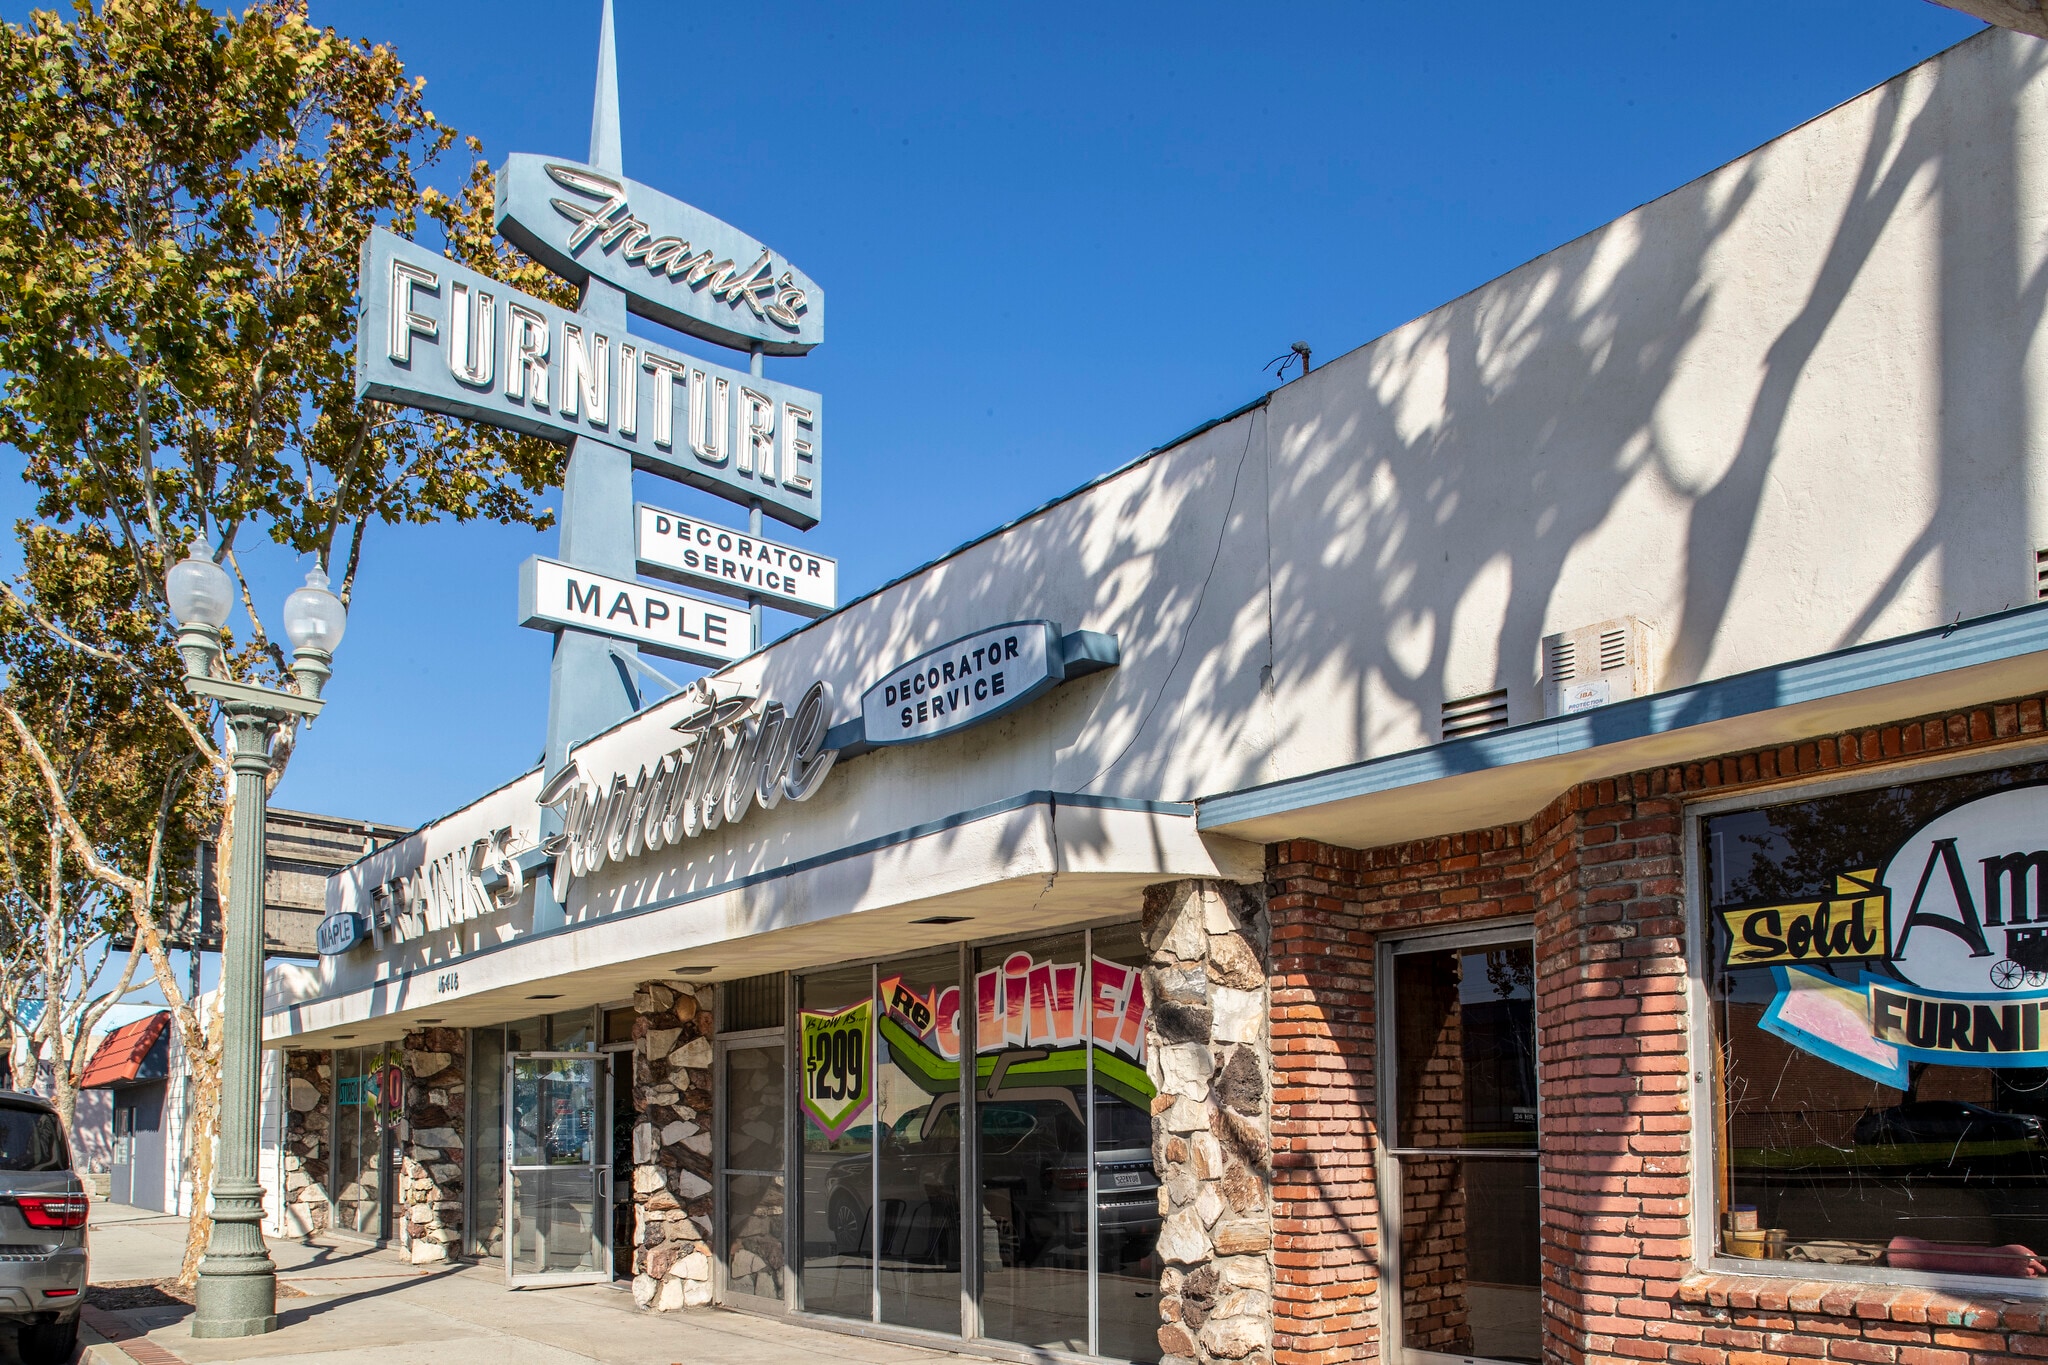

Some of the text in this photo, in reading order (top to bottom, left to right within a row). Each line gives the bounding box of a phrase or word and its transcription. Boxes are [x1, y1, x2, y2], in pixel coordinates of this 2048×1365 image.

[543, 161, 809, 329] Frank's
[387, 257, 814, 493] FURNITURE
[655, 514, 822, 579] DECORATOR
[683, 548, 797, 596] SERVICE
[566, 577, 729, 648] MAPLE
[884, 635, 1020, 707] DECORATOR
[900, 671, 1006, 729] SERVICE
[1568, 698, 1604, 710] PROTECTION
[321, 919, 351, 949] MAPLE
[1734, 899, 1878, 959] Sold
[817, 1015, 841, 1031] LOW
[807, 1028, 863, 1101] $299
